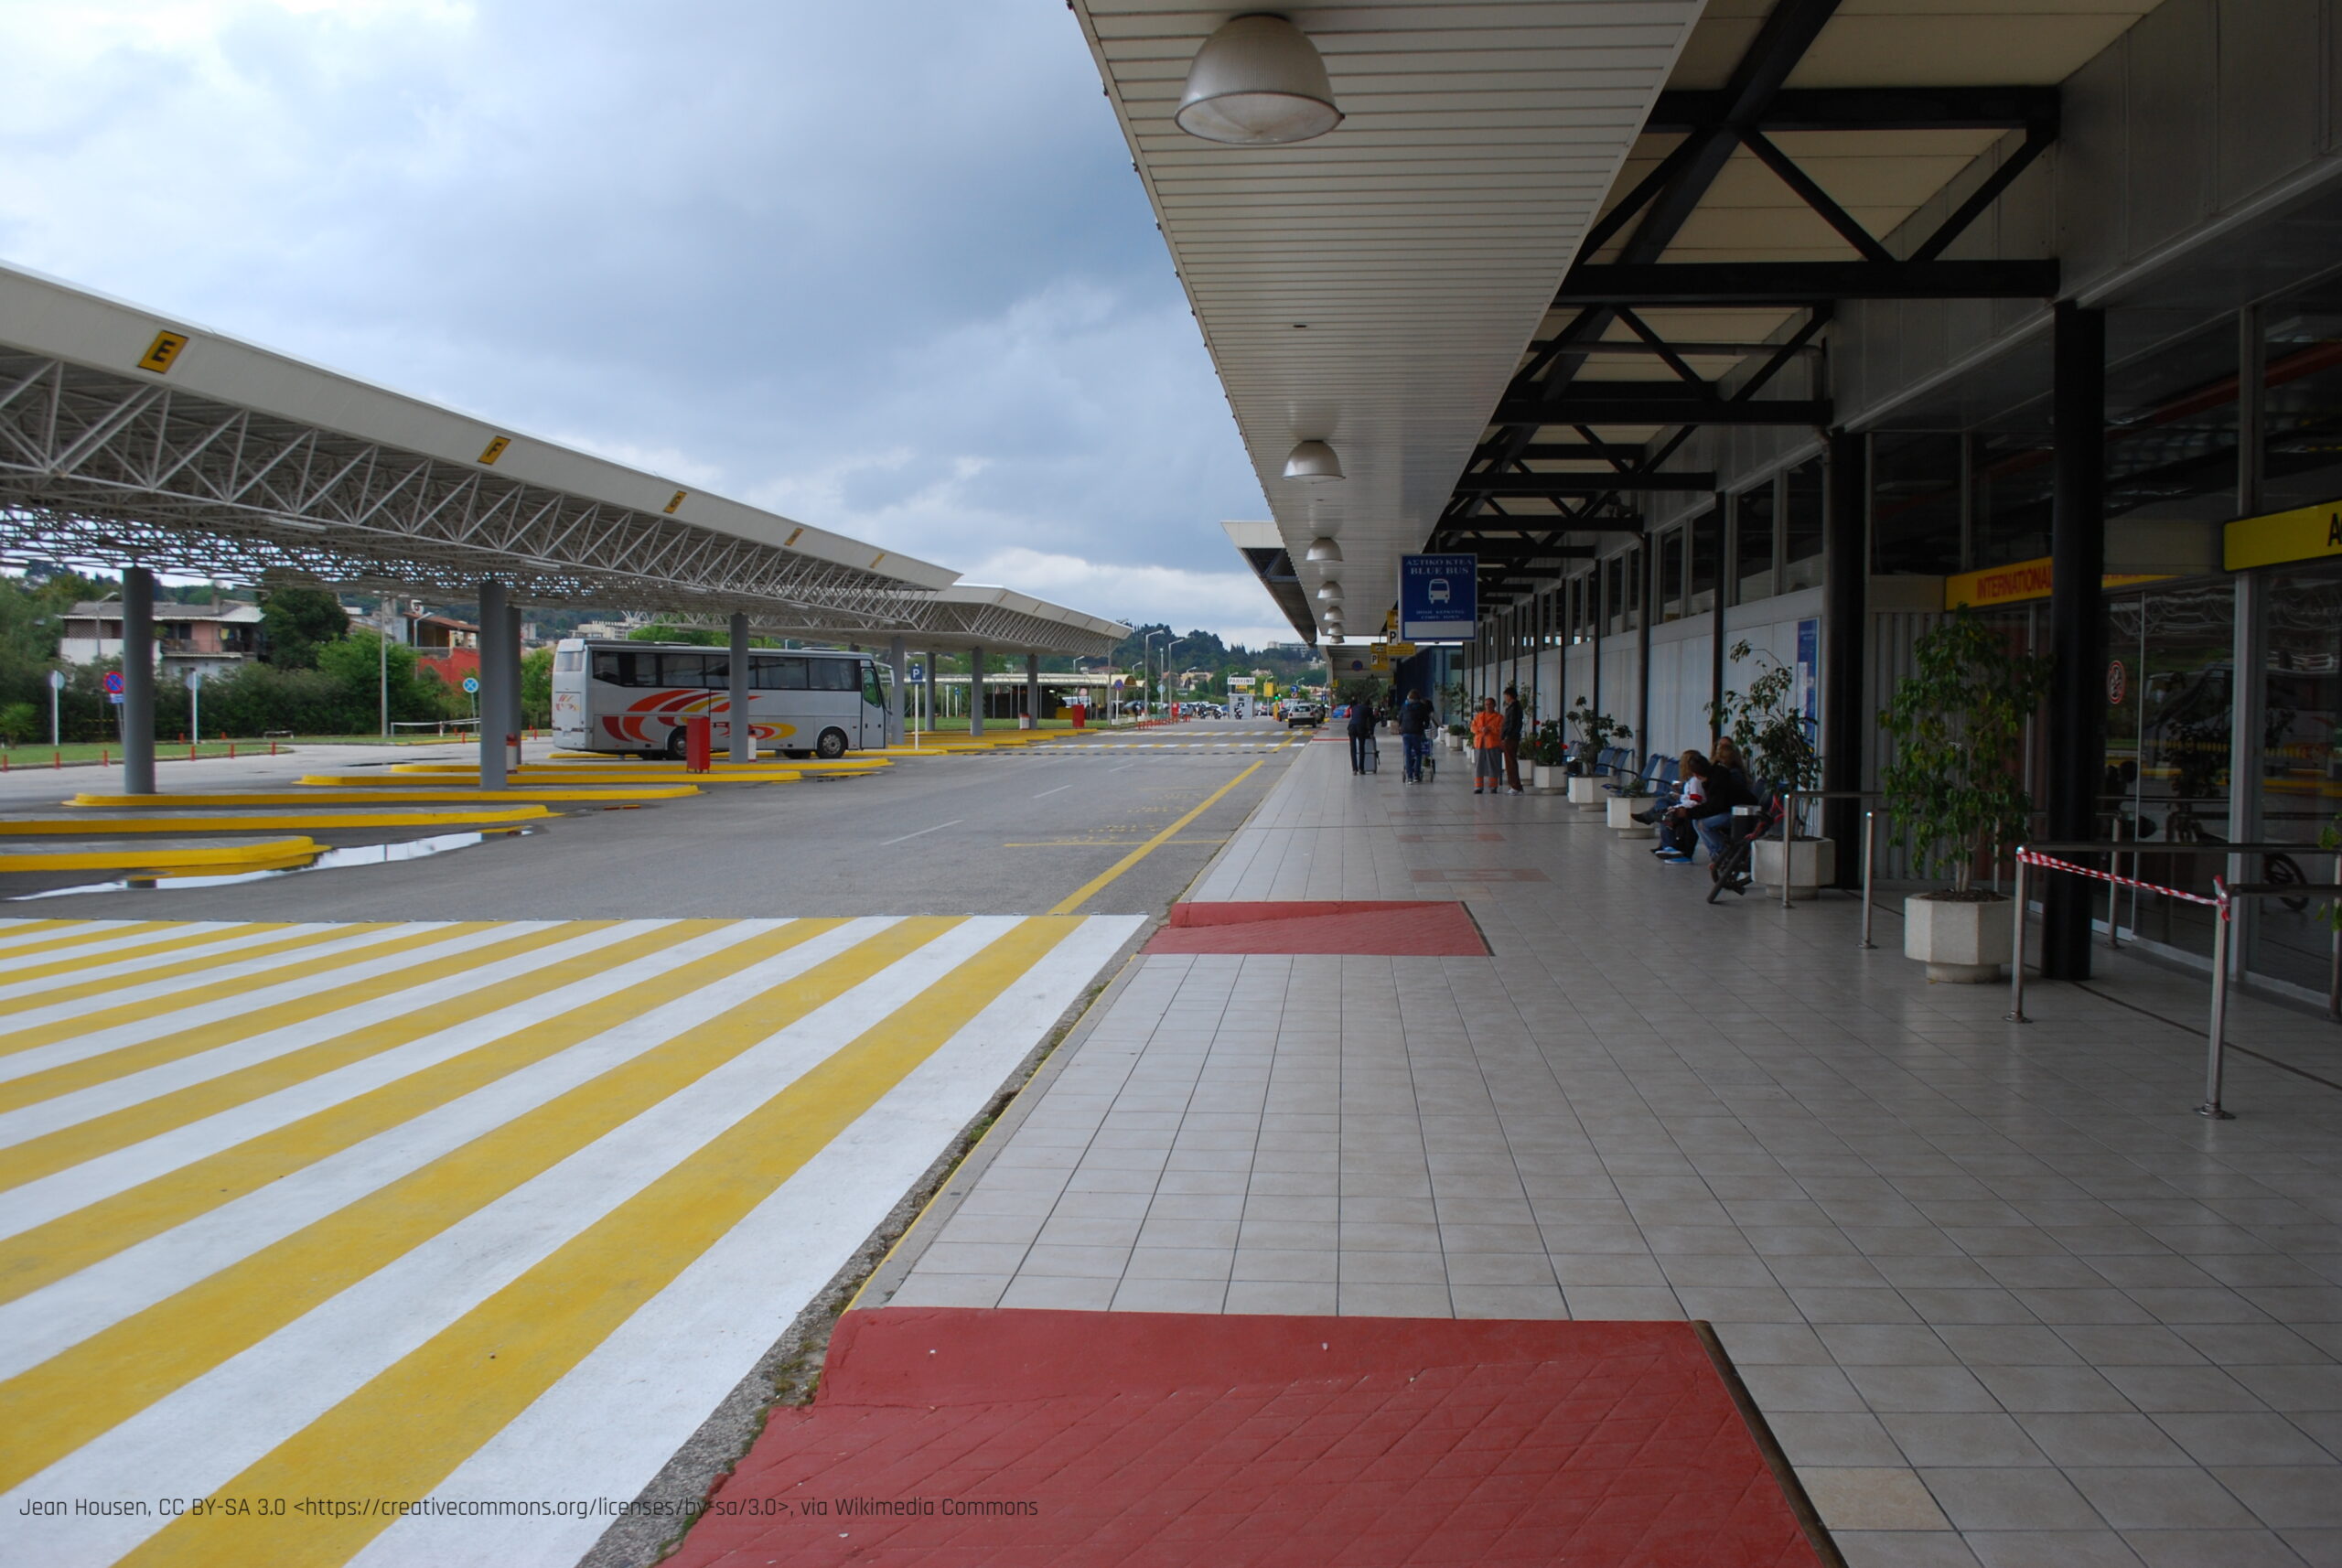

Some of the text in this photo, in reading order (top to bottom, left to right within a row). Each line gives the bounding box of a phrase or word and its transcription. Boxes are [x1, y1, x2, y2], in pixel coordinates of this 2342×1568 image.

[151, 339, 177, 363] E
[486, 442, 502, 456] F
[2327, 512, 2342, 546] A
[1390, 631, 1397, 644] P
[1372, 655, 1377, 663] P
[912, 668, 920, 678] P
